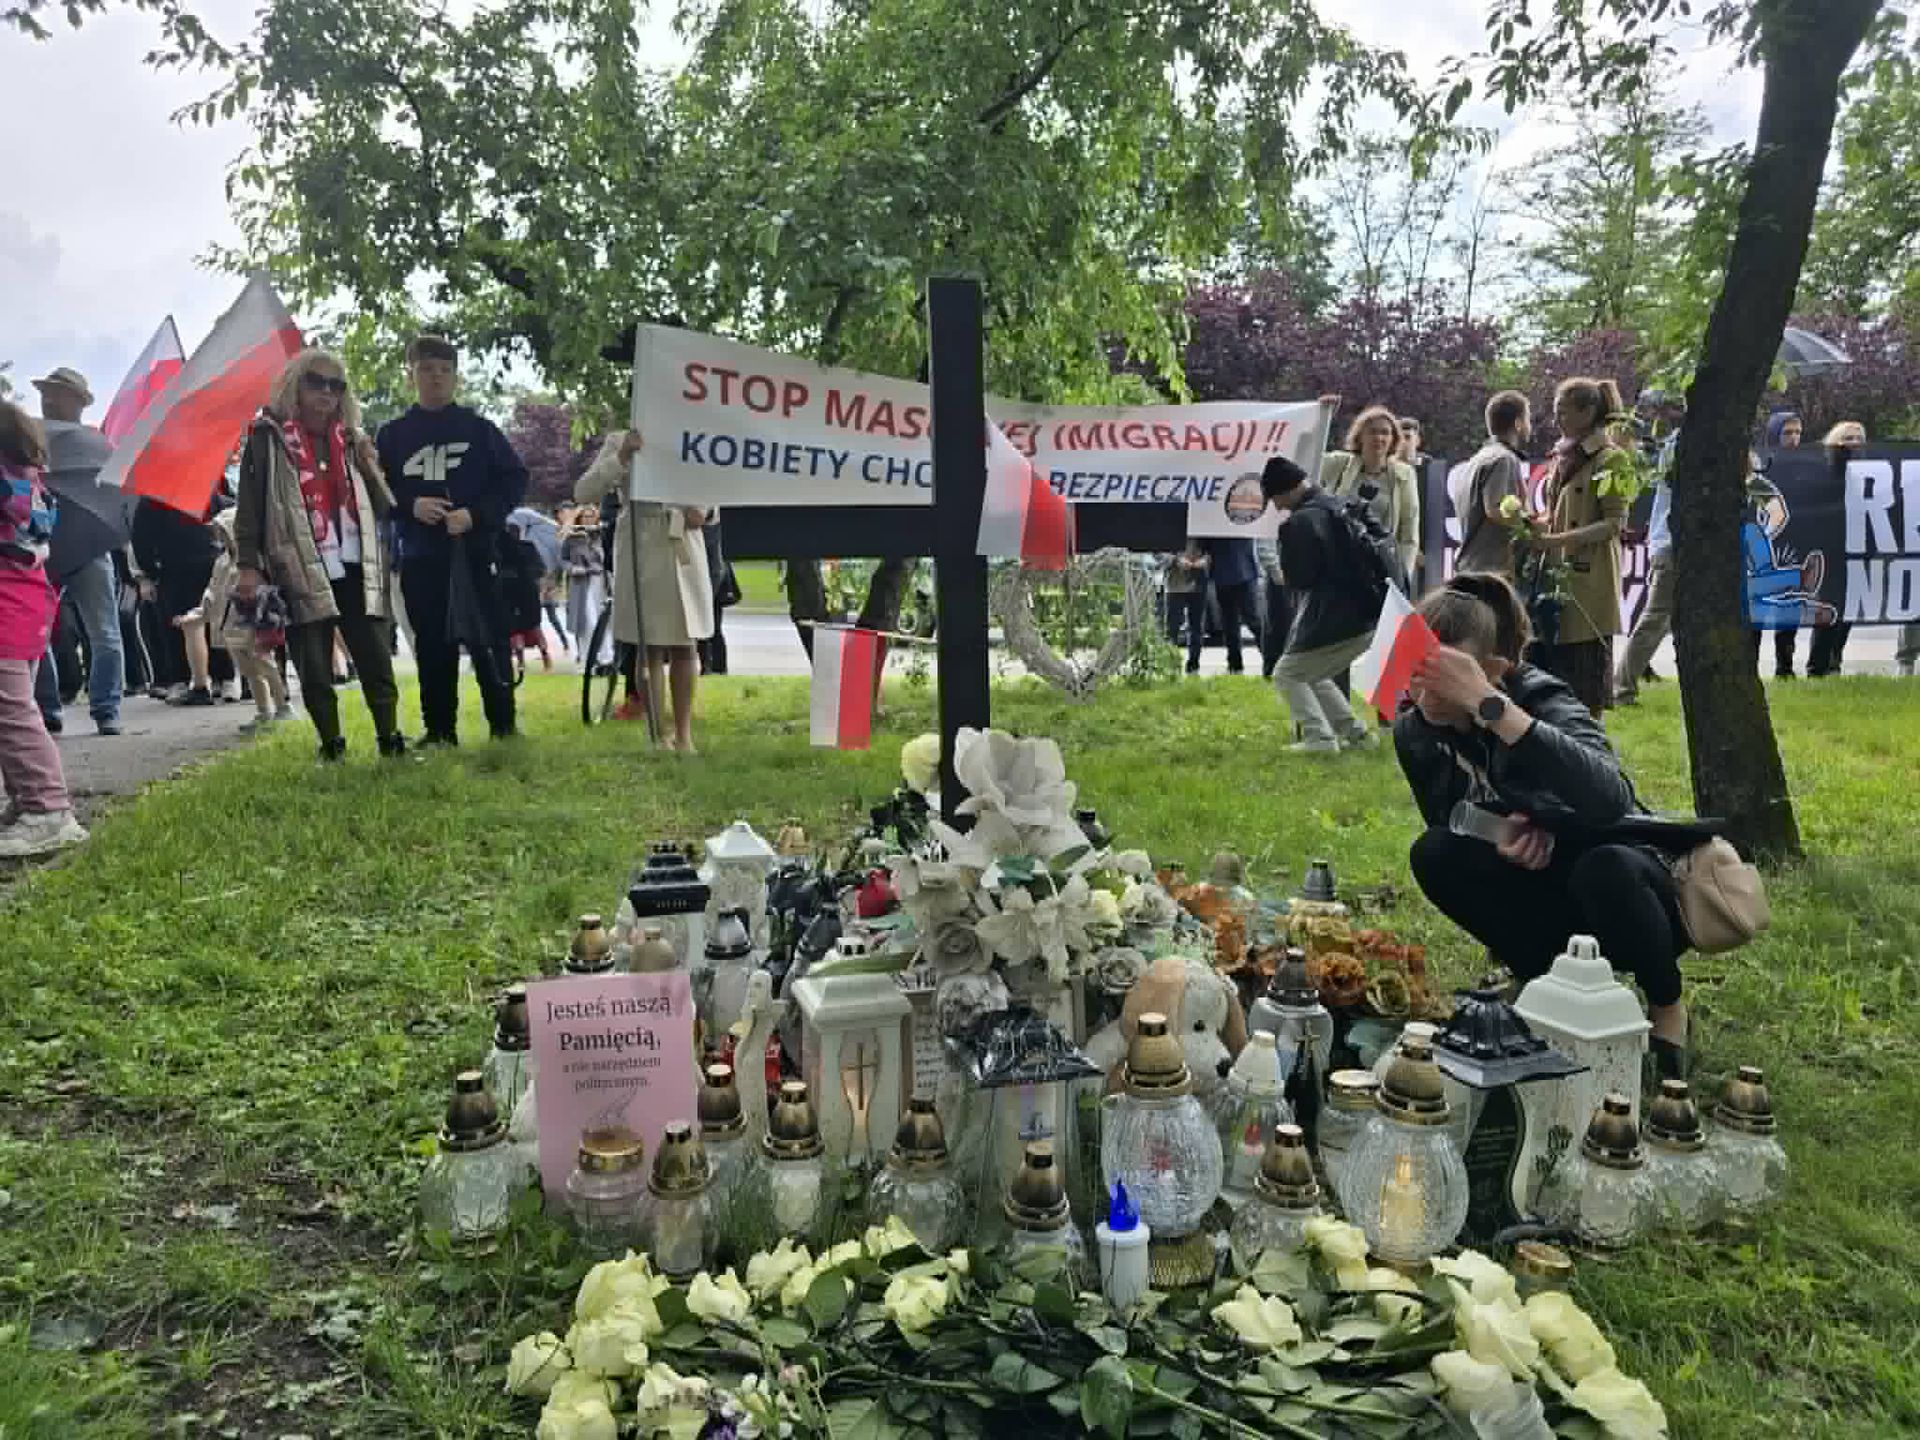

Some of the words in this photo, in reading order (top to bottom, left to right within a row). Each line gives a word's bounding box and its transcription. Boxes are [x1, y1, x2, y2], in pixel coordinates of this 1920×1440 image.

[682, 362, 809, 417] STOP
[403, 442, 470, 480] 4F
[681, 430, 849, 479] KOBIETY
[862, 454, 931, 488] CHC
[1050, 471, 1225, 500] BEZPIECZNE
[547, 993, 606, 1023] Jesteś
[611, 996, 671, 1017] naszą
[559, 1026, 661, 1052] Pamięcią,
